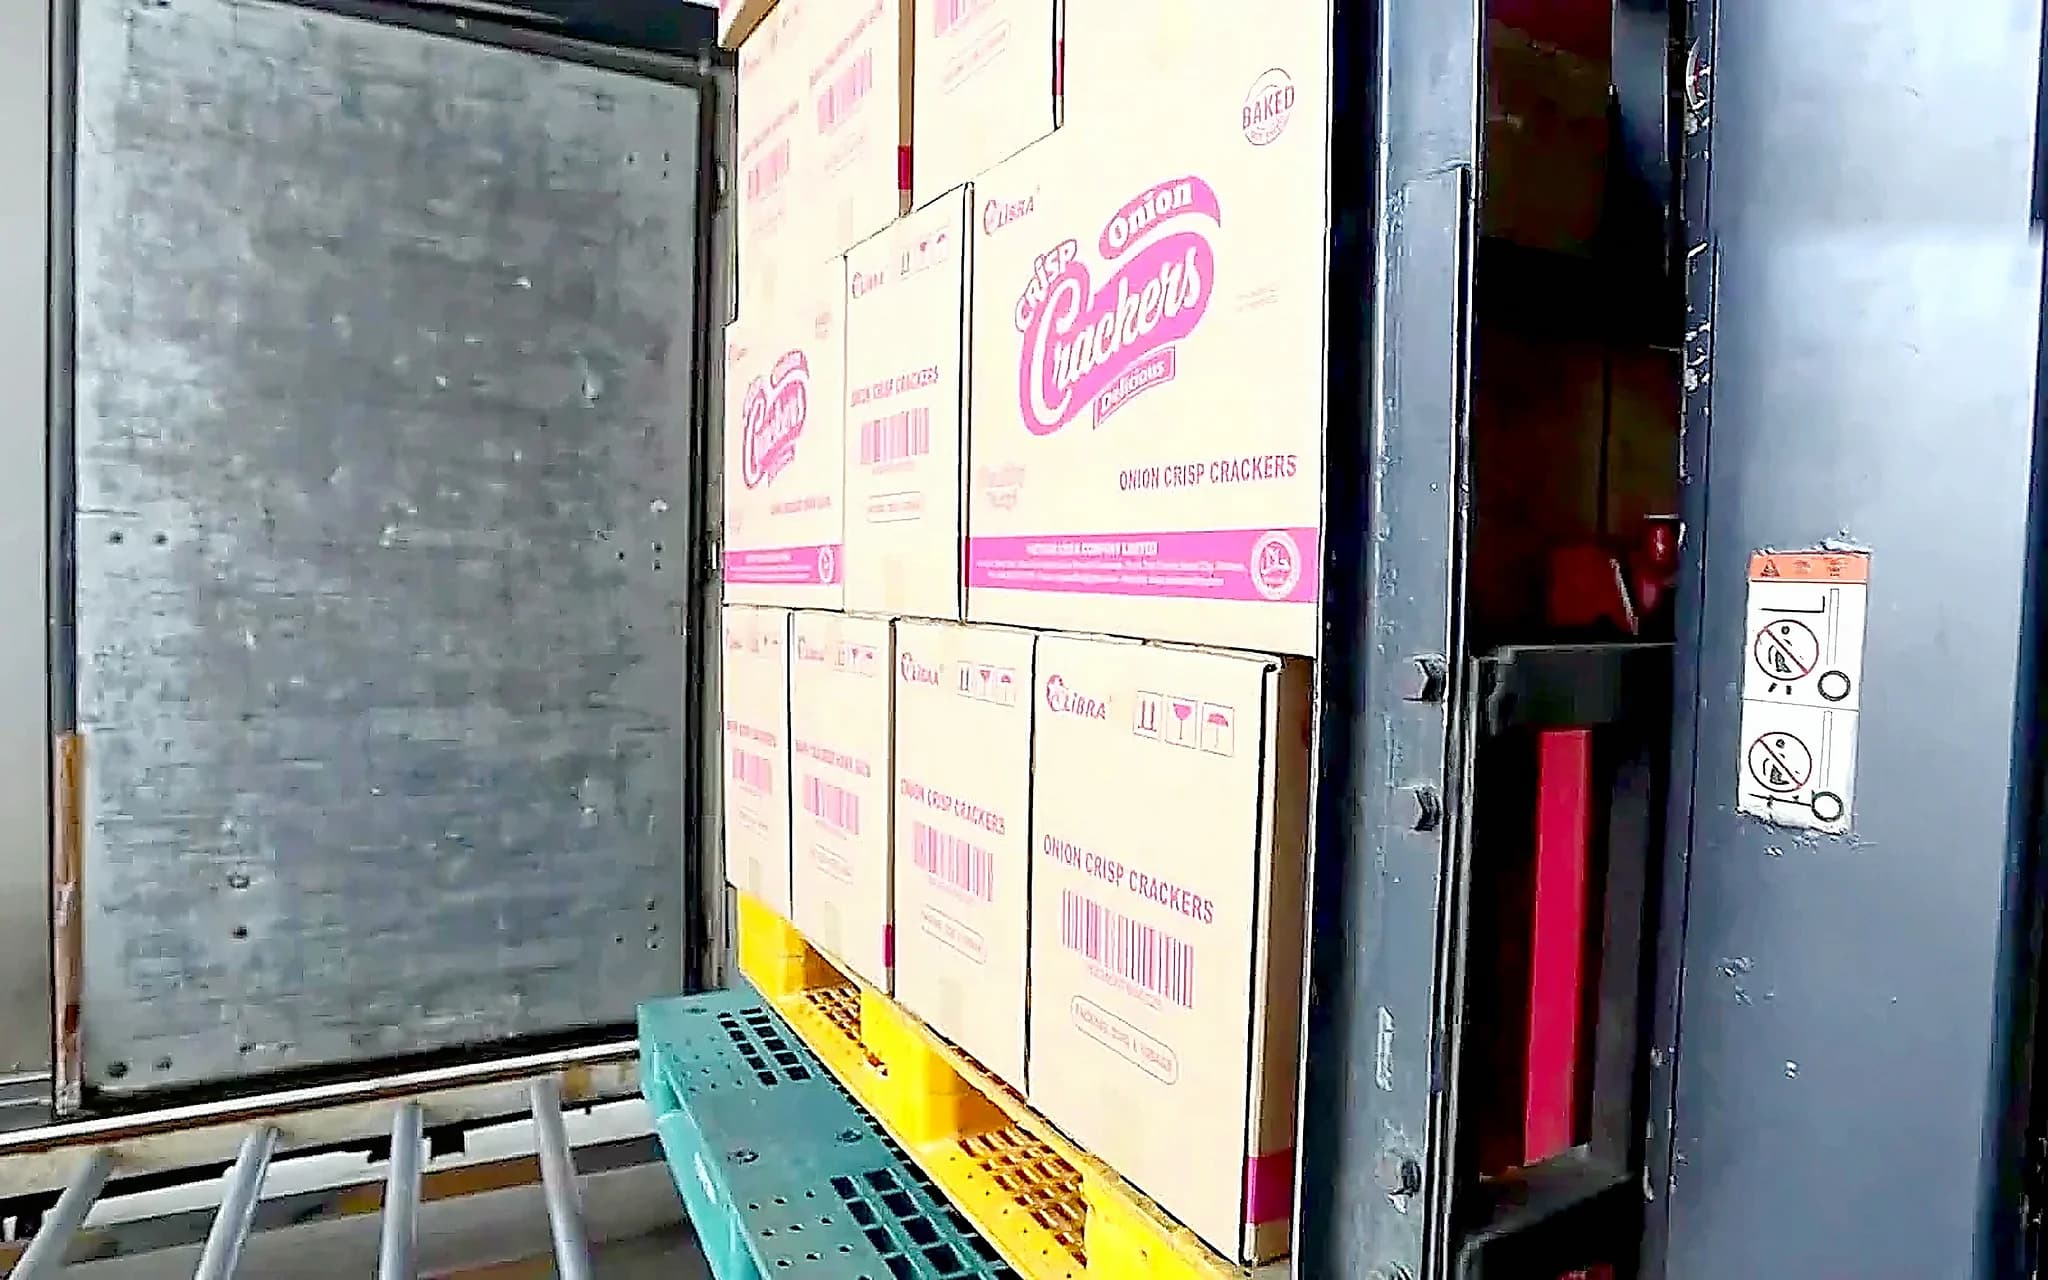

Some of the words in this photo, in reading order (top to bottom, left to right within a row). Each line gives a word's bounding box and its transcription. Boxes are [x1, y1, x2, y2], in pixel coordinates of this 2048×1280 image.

[1242, 85, 1295, 131] BAKED
[1108, 182, 1193, 249] Onion
[1030, 246, 1201, 426] Crackers
[1119, 467, 1160, 491] ONION
[1164, 463, 1205, 488] CRISP
[1210, 454, 1298, 484] CRACKERS
[1043, 834, 1082, 871] ONION
[1085, 852, 1124, 886] CRISP
[1129, 869, 1215, 924] CRACKERS
